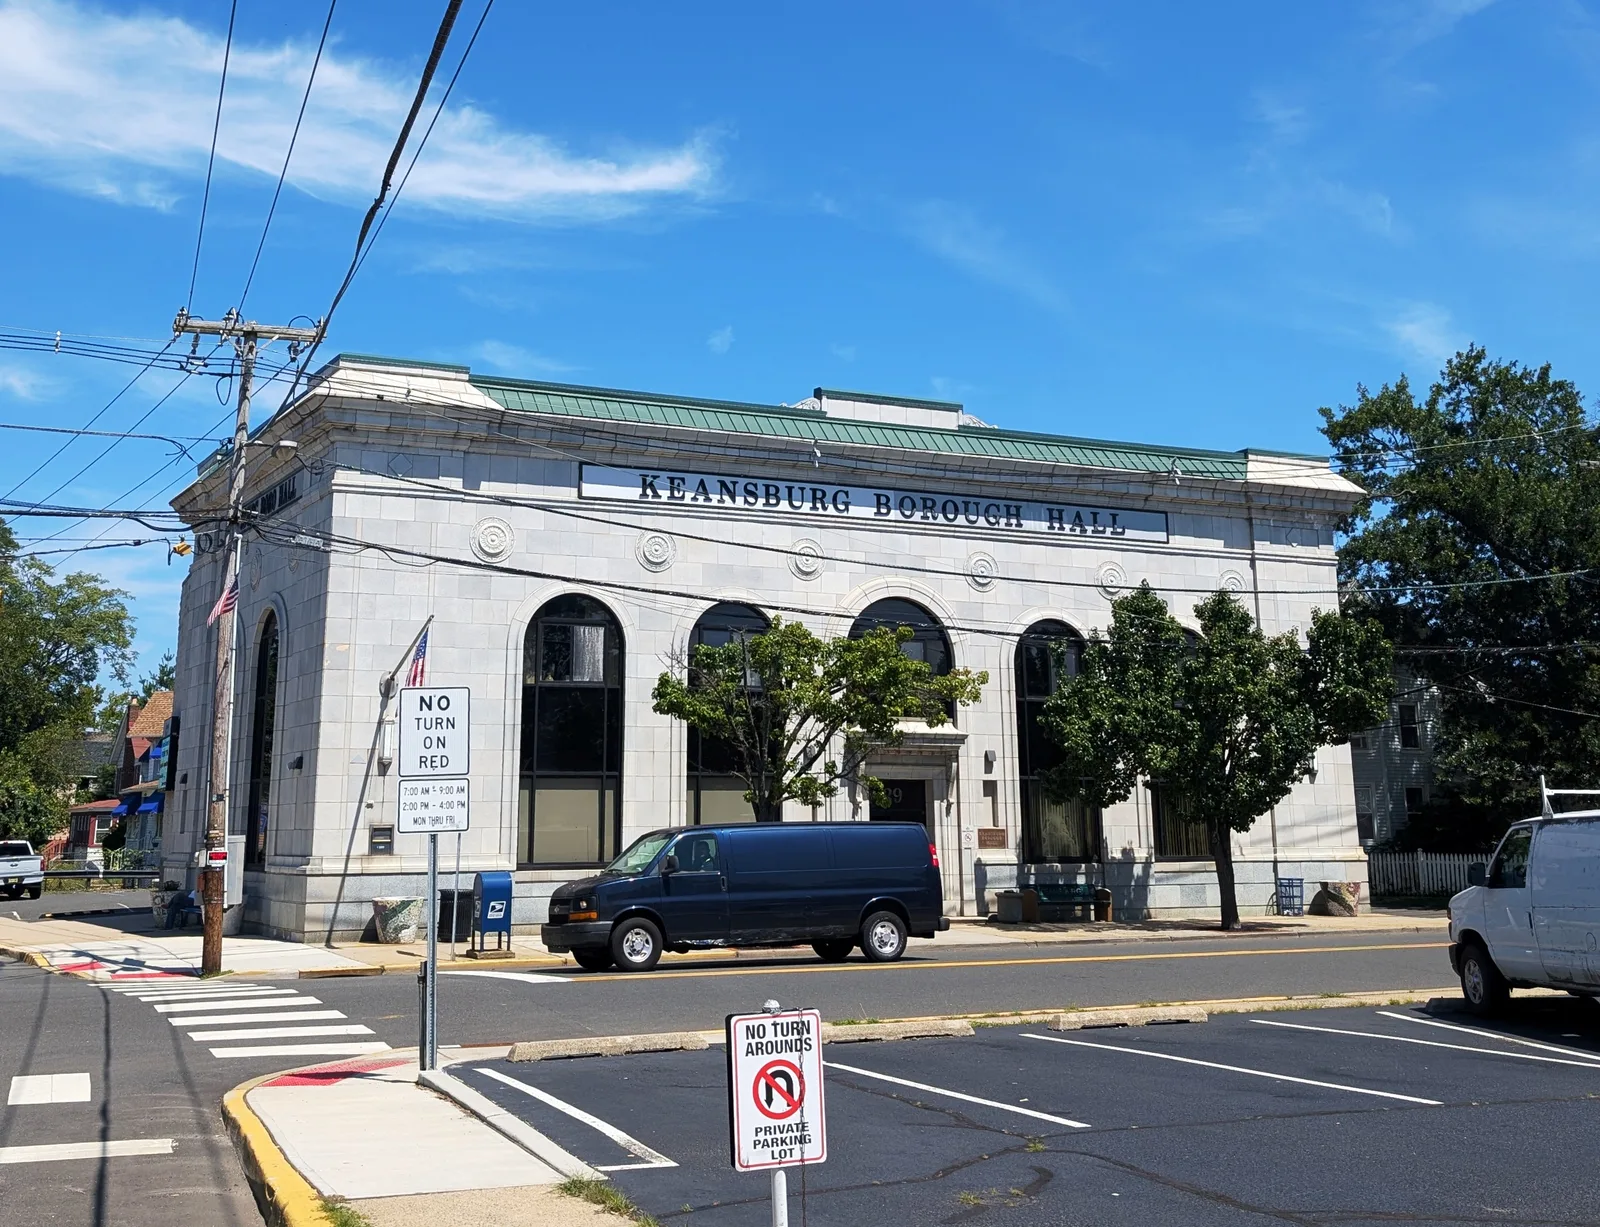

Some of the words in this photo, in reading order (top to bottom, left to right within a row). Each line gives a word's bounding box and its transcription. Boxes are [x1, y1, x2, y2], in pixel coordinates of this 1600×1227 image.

[638, 474, 852, 514] KEANSBURG
[873, 493, 1024, 528] BOROUGH
[1046, 508, 1126, 536] HALL
[419, 695, 451, 711] NO
[414, 716, 456, 731] TURN
[423, 736, 446, 750] ON
[419, 754, 450, 769] RED
[403, 786, 419, 796] 7:00
[420, 786, 430, 796] AM
[438, 786, 454, 795] 9:00
[456, 785, 465, 795] AM
[402, 801, 418, 811] 2:00
[420, 801, 429, 811] PM
[439, 800, 454, 810] 4:00
[457, 800, 466, 810] PM
[413, 816, 427, 826] MON
[428, 816, 444, 826] THRU
[445, 815, 456, 825] FRI
[745, 1023, 766, 1040] NO
[771, 1020, 811, 1038] TURN
[745, 1037, 813, 1057] AROUNDS
[754, 1121, 810, 1138] PRIVATE
[753, 1133, 812, 1150] PARKING
[771, 1148, 795, 1160] LOT
